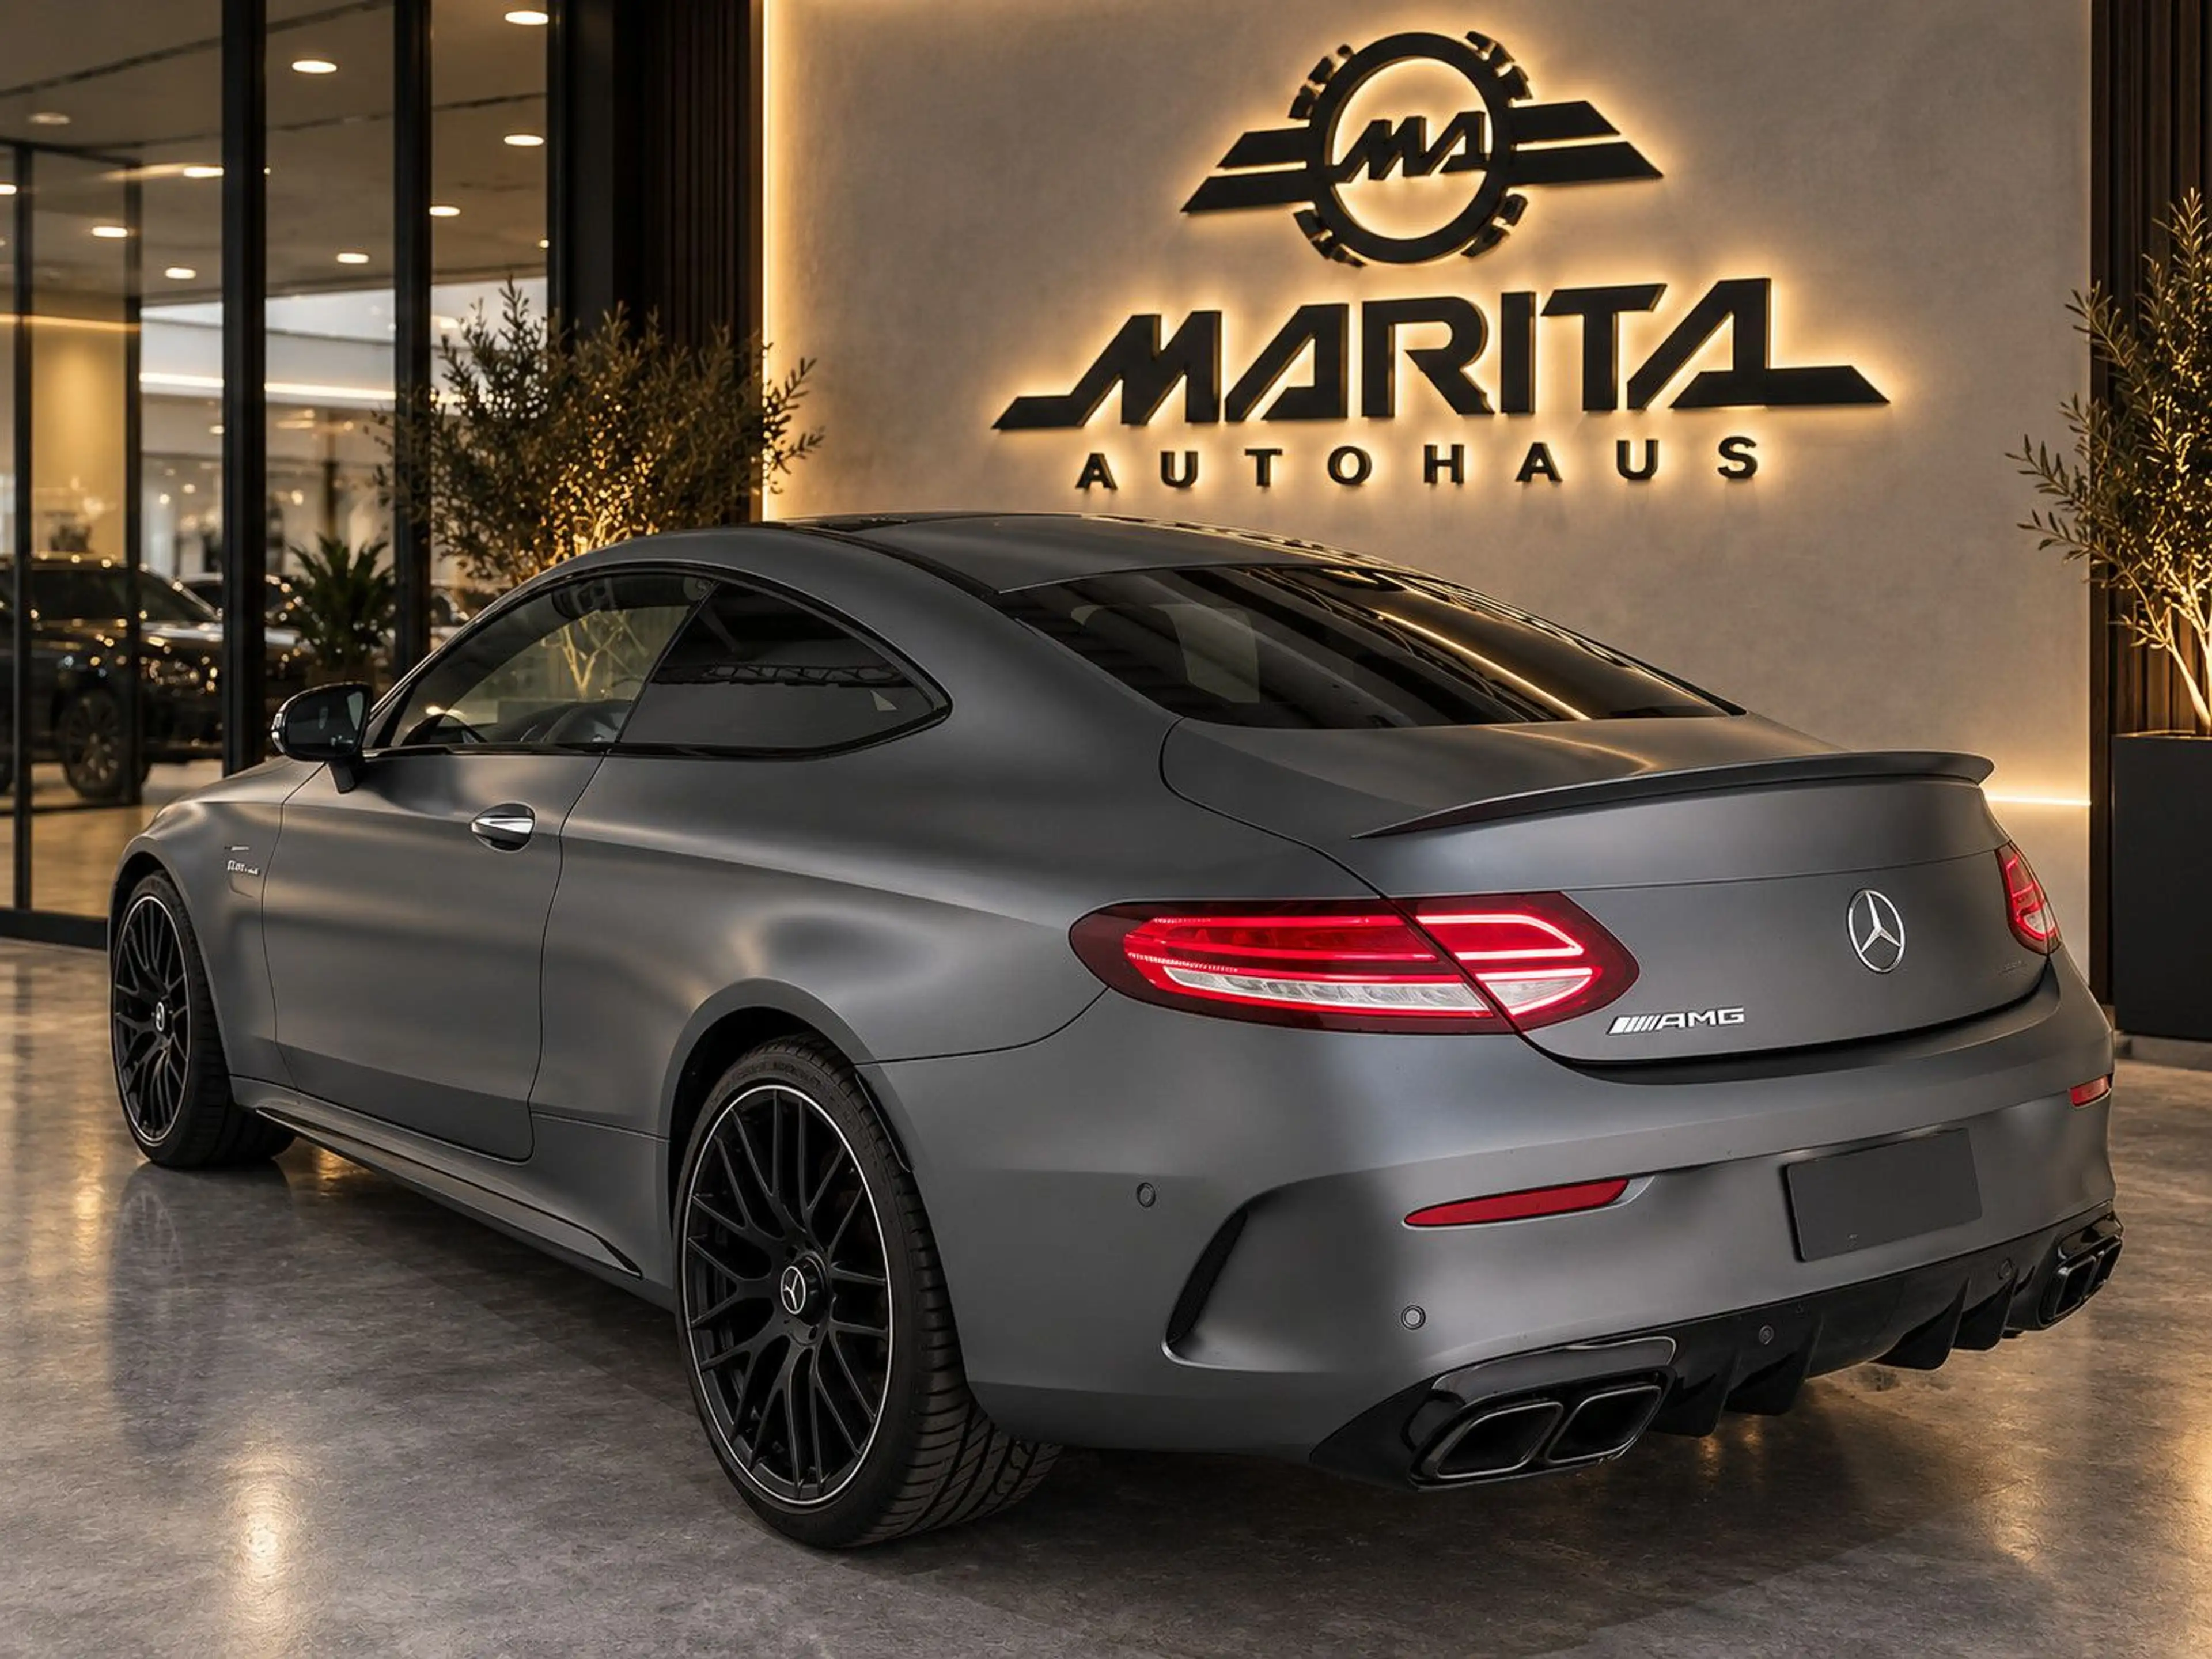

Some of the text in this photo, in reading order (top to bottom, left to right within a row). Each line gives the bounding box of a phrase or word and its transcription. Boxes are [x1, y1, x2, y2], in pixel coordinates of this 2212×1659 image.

[1331, 110, 1490, 181] MA
[991, 278, 1891, 430] MARITA
[1075, 436, 1758, 490] AUTOHAUS
[1654, 1007, 1745, 1031] AMG
